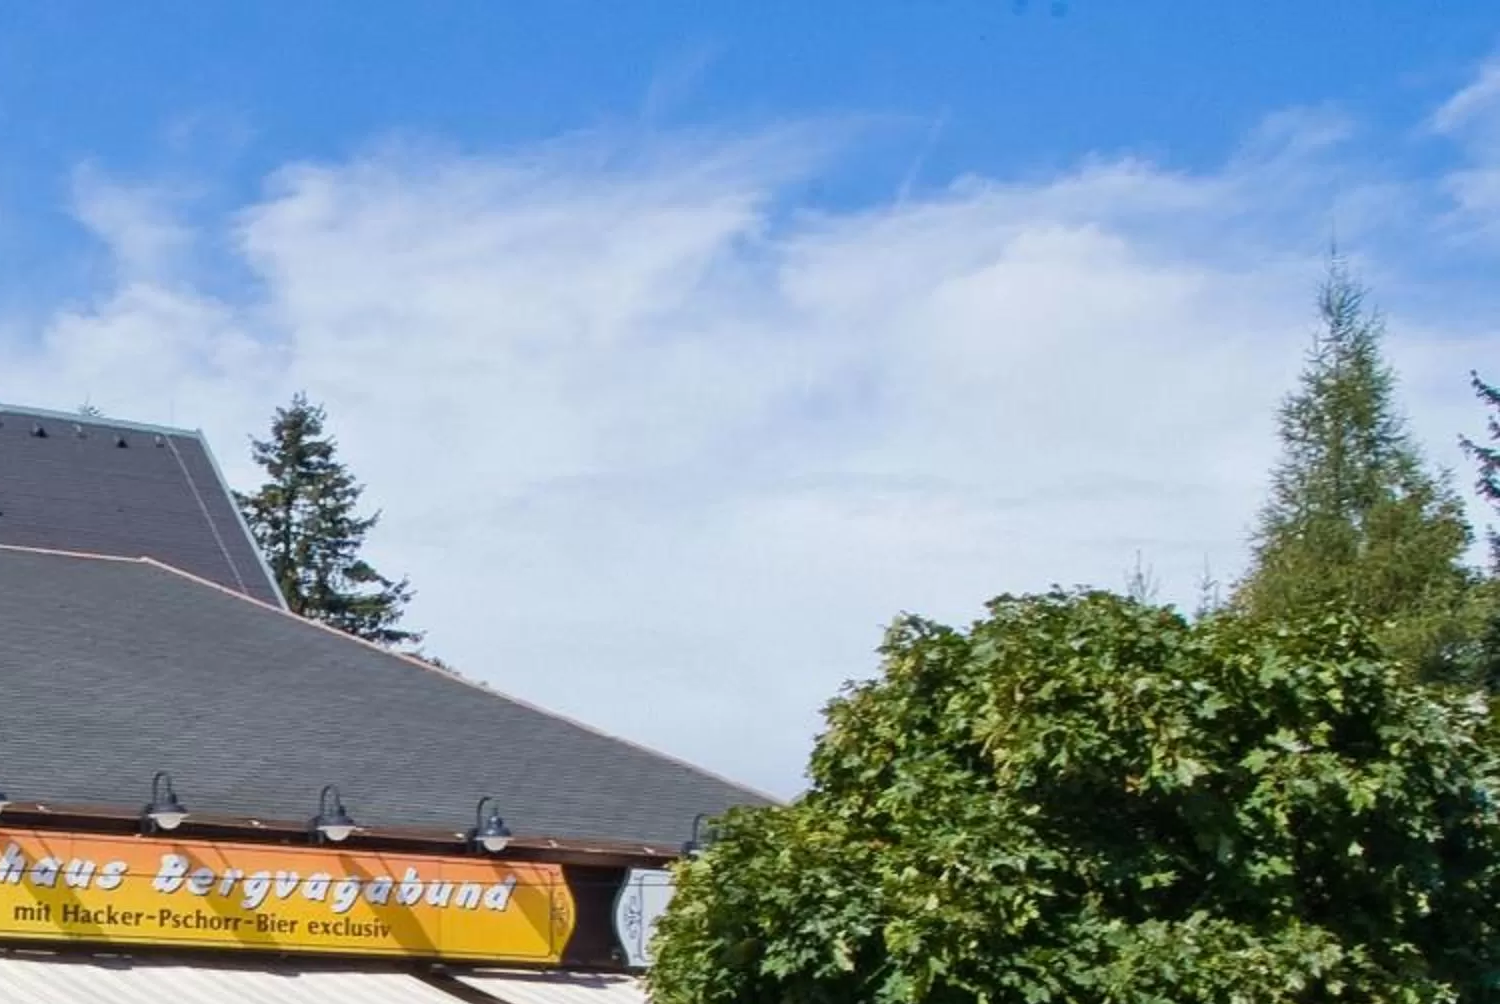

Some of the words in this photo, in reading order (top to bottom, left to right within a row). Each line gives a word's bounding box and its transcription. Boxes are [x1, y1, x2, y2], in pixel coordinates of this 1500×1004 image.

[154, 853, 515, 912] Bergvagabund
[14, 903, 52, 923] mit
[62, 904, 299, 935] Hacker-Pschorr-Bier
[307, 917, 392, 939] exclusiv
